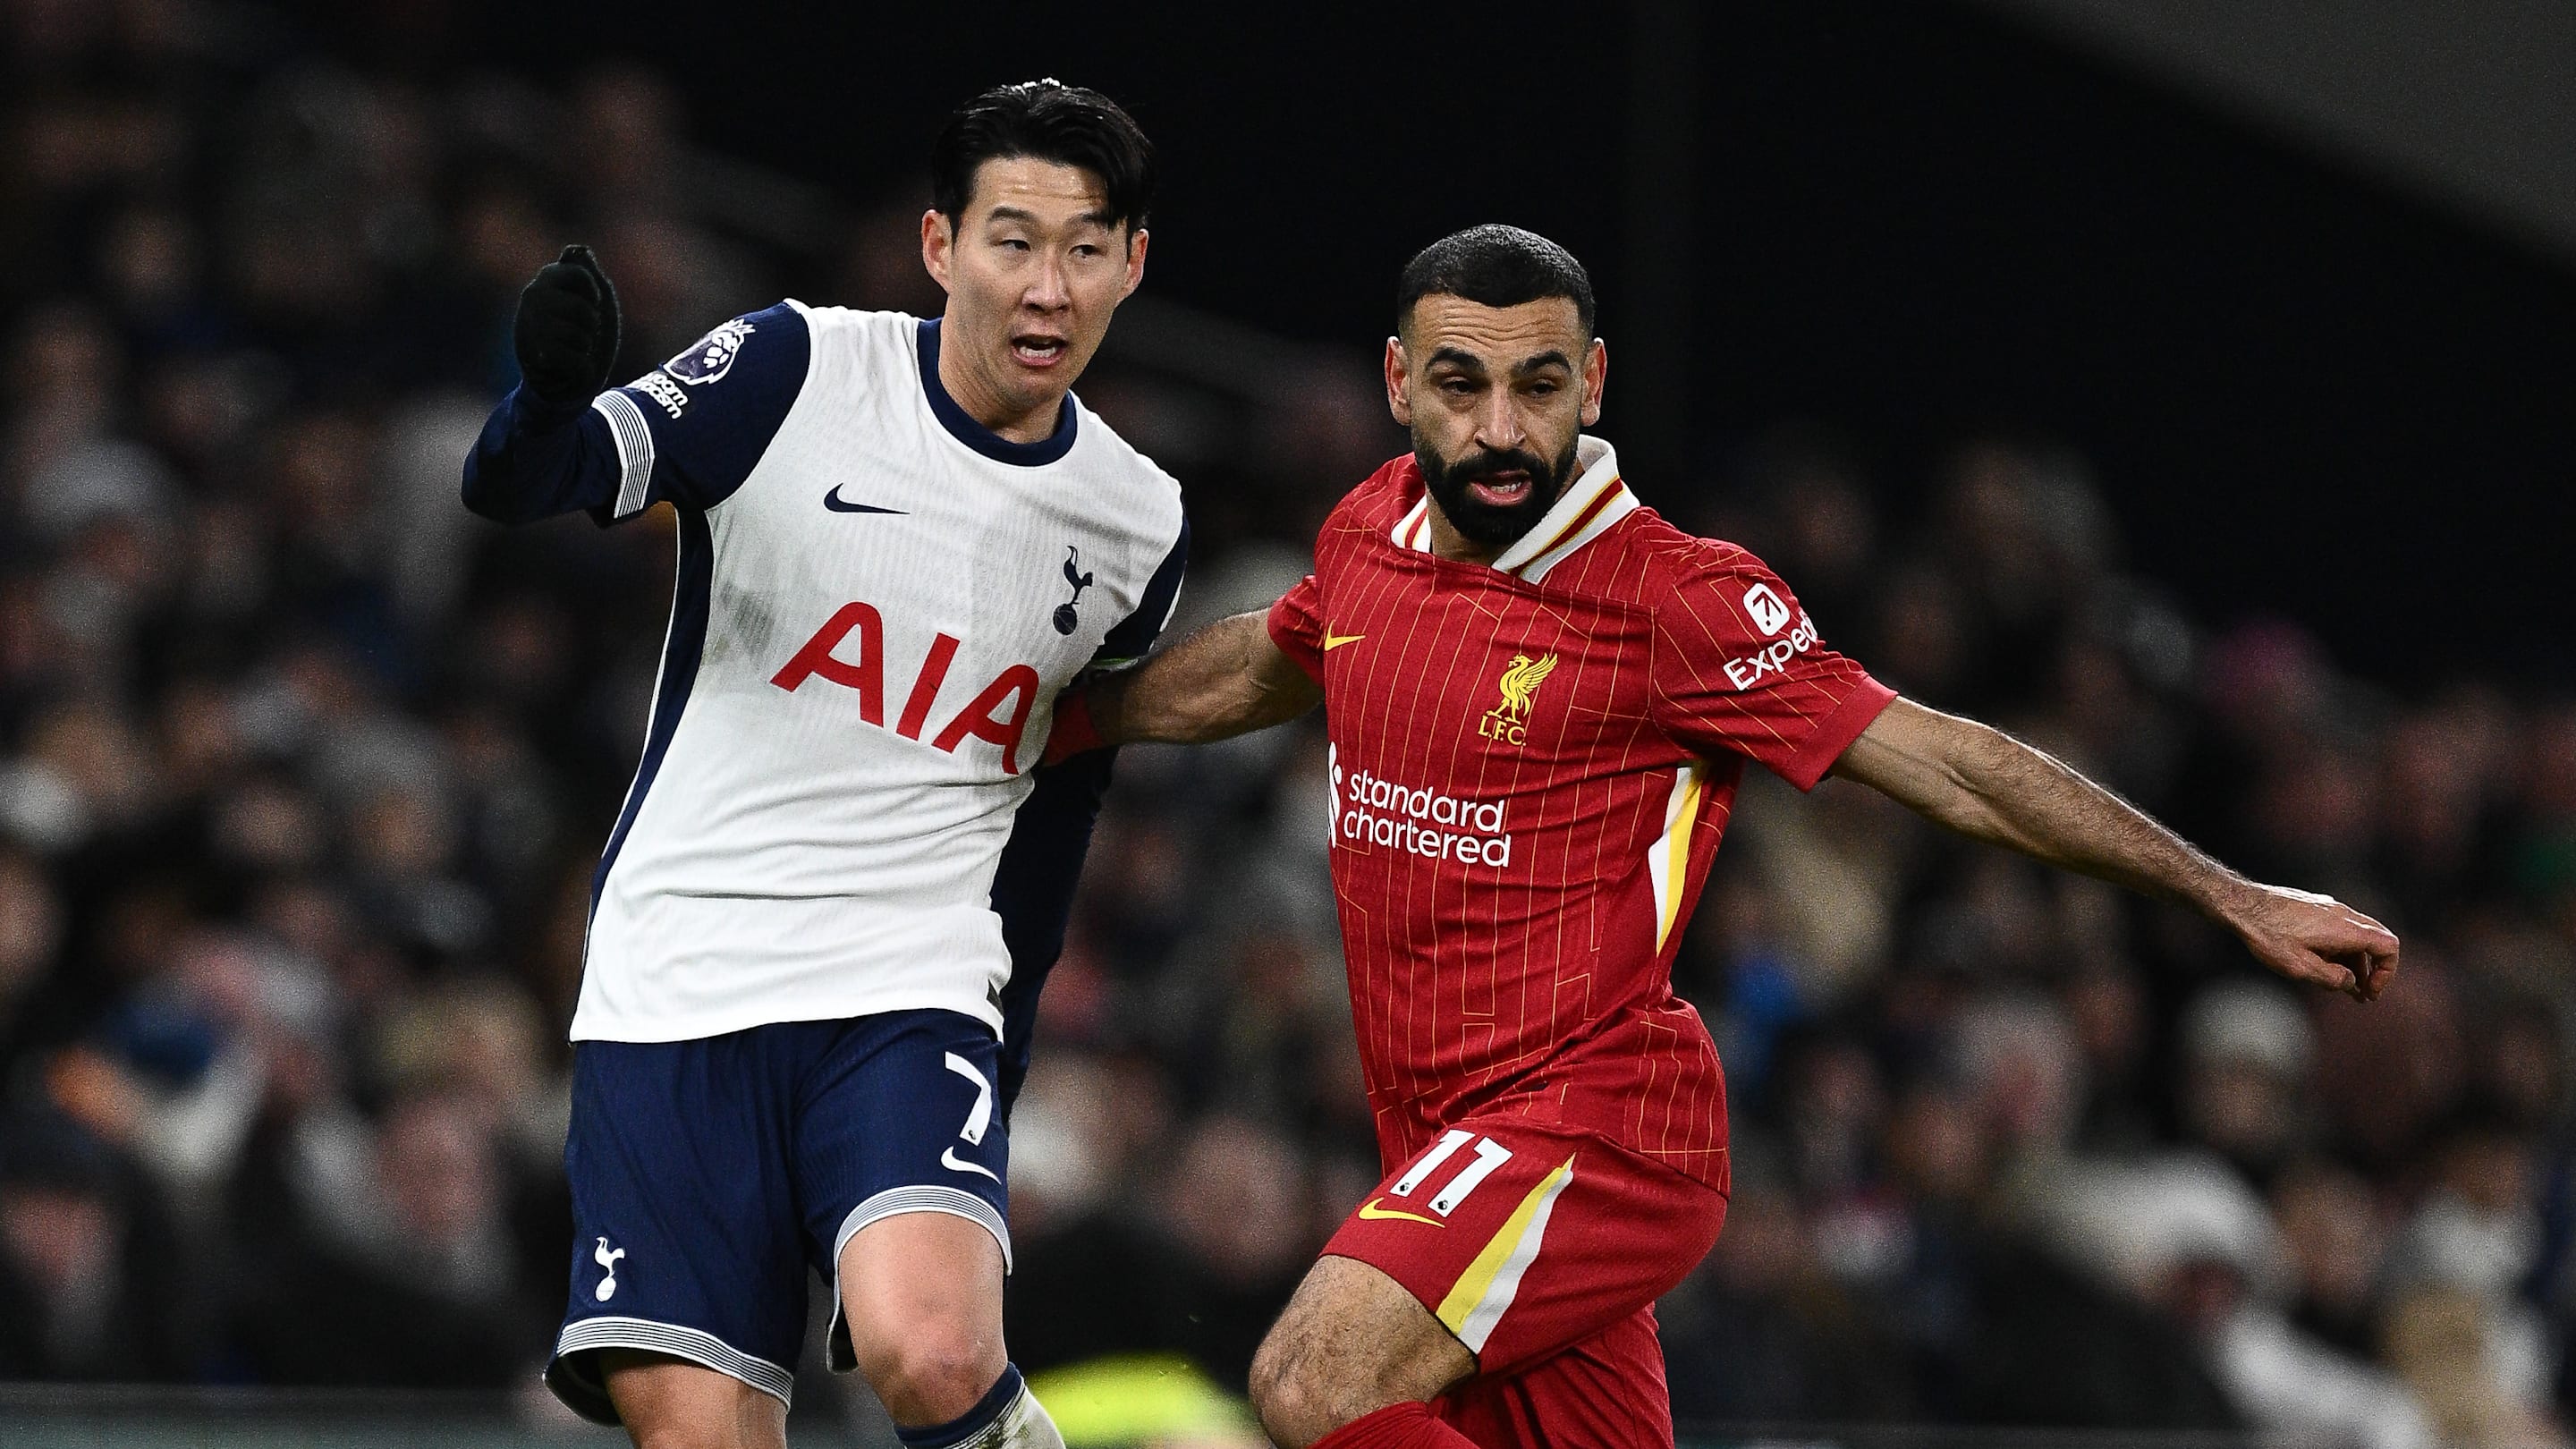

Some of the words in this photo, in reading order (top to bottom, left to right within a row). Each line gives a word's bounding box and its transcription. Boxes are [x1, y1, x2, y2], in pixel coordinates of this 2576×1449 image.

[769, 601, 1039, 776] AIA
[1343, 806, 1512, 868] chartered
[1349, 769, 1504, 834] standard
[945, 1051, 993, 1147] 7
[1389, 1129, 1514, 1217] 11
